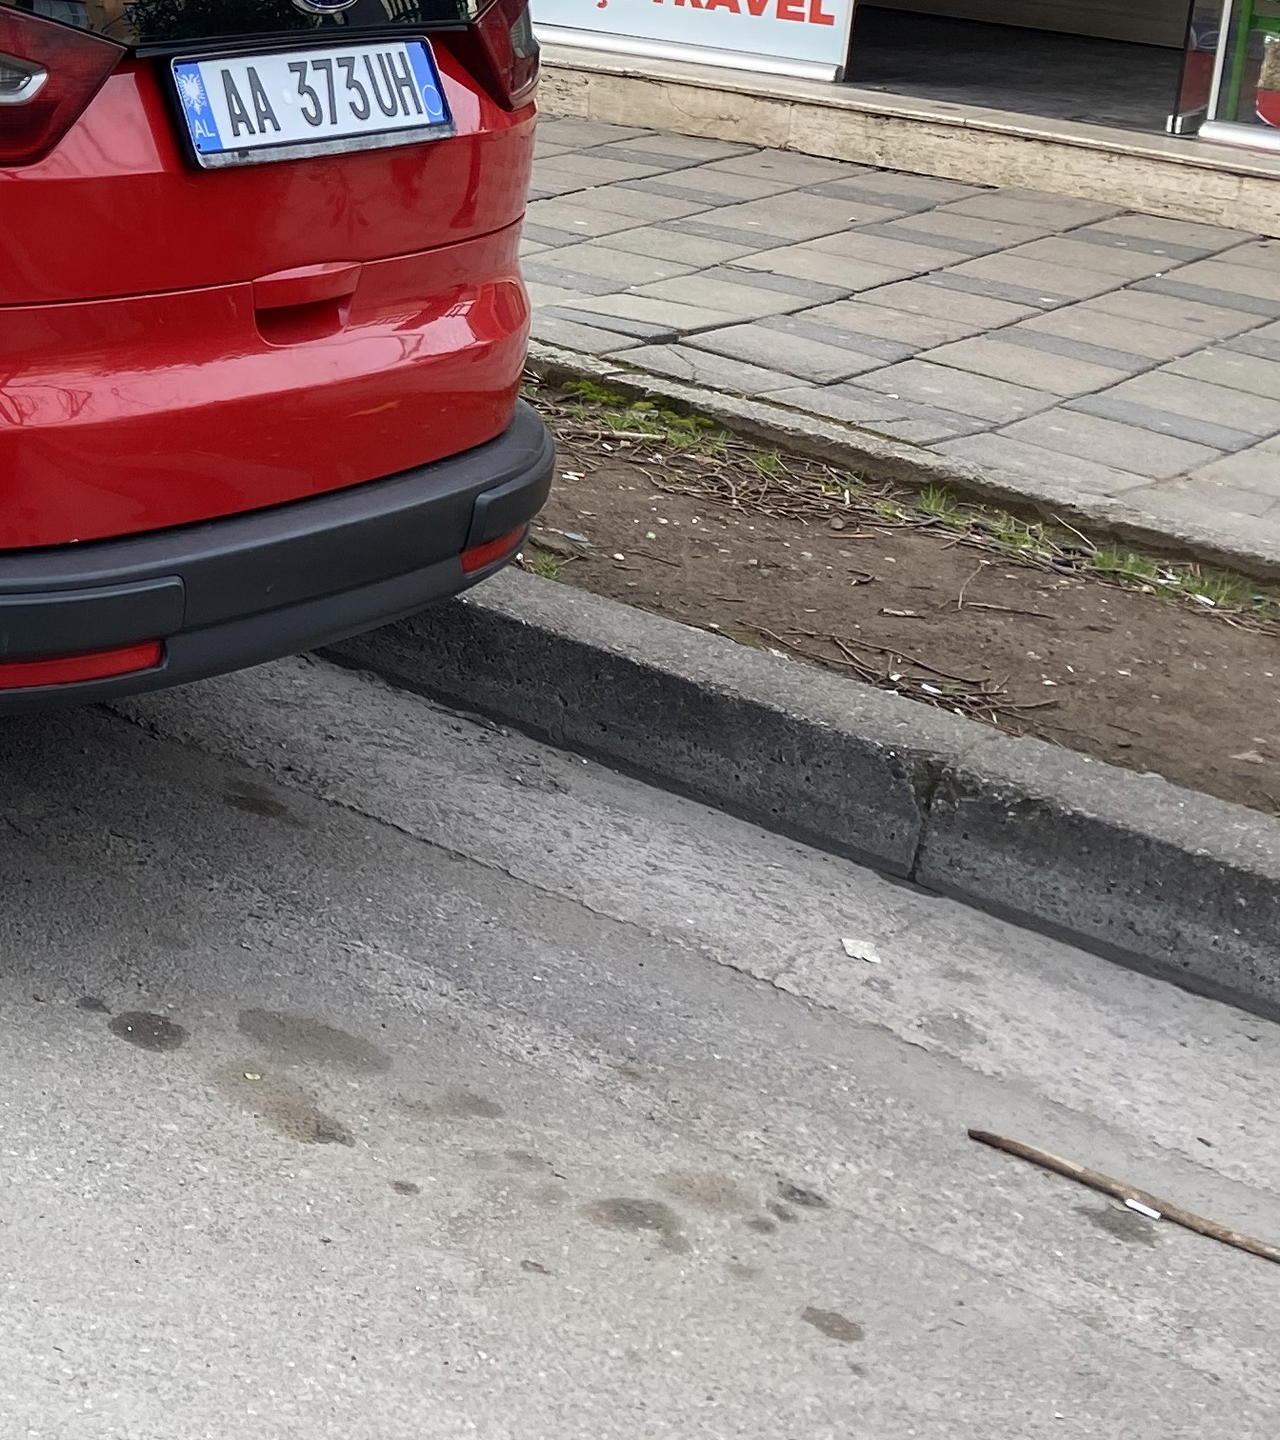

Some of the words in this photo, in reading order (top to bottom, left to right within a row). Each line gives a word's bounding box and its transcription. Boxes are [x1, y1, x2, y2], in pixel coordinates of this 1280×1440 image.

[194, 118, 216, 139] AL
[220, 66, 281, 137] AA
[288, 51, 424, 127] 373UH
